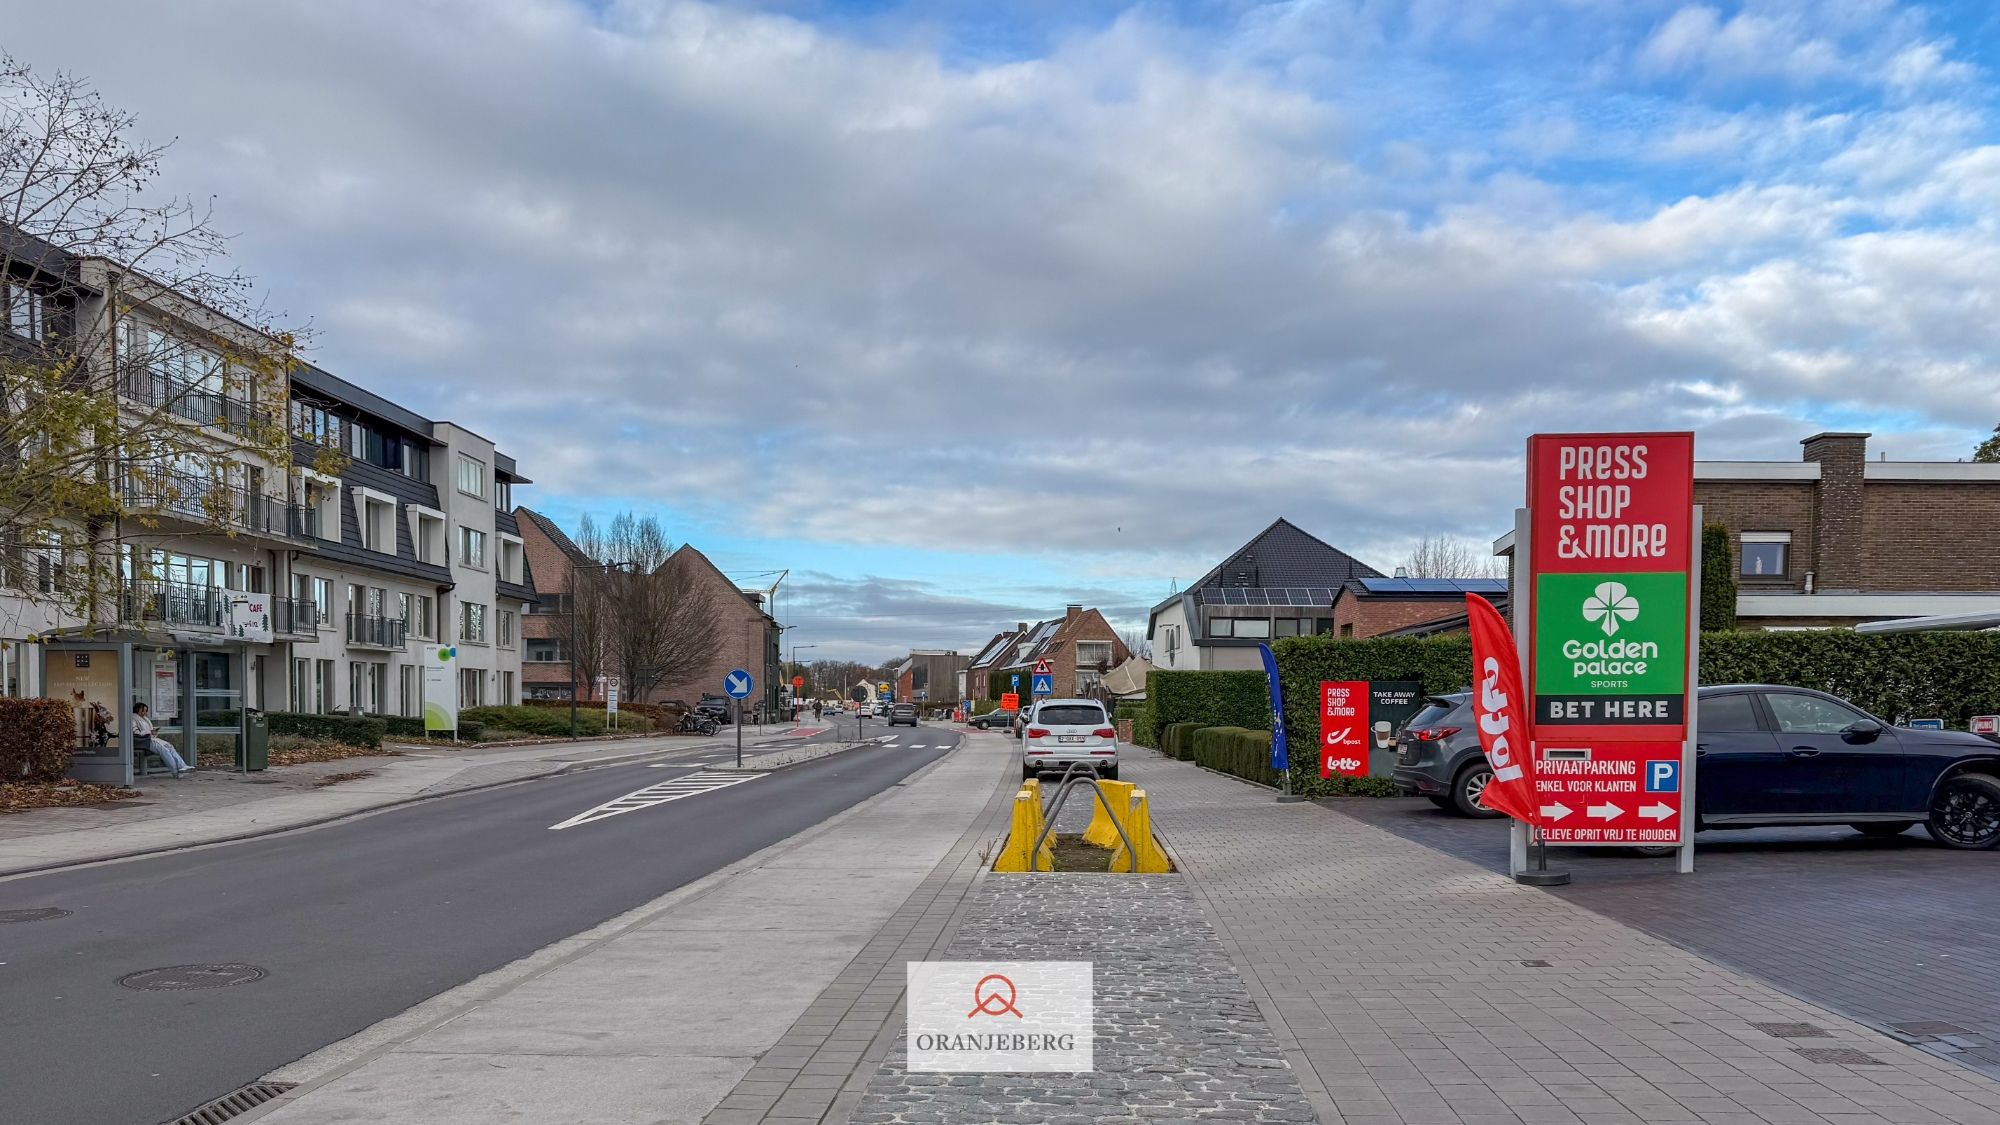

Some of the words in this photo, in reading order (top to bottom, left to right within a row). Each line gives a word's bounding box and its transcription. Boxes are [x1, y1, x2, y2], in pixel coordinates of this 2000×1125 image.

[1559, 485, 1630, 519] SHOP
[1562, 638, 1658, 660] Golden
[1573, 659, 1647, 678] palace
[1590, 680, 1628, 688] SPORTS
[1327, 698, 1346, 707] SHOP
[1550, 700, 1595, 719] BET
[1604, 700, 1669, 719] HERE
[1535, 760, 1636, 775] PRIVAATPARKING
[1653, 763, 1674, 790] P
[1536, 780, 1565, 792] ENKEL
[1567, 780, 1592, 792] VOOR
[1595, 780, 1637, 792] KLANTEN
[1574, 828, 1602, 840] OPRIT
[1603, 828, 1624, 840] VRIJ
[1626, 828, 1637, 840] TE
[1639, 828, 1677, 840] HOUDEN
